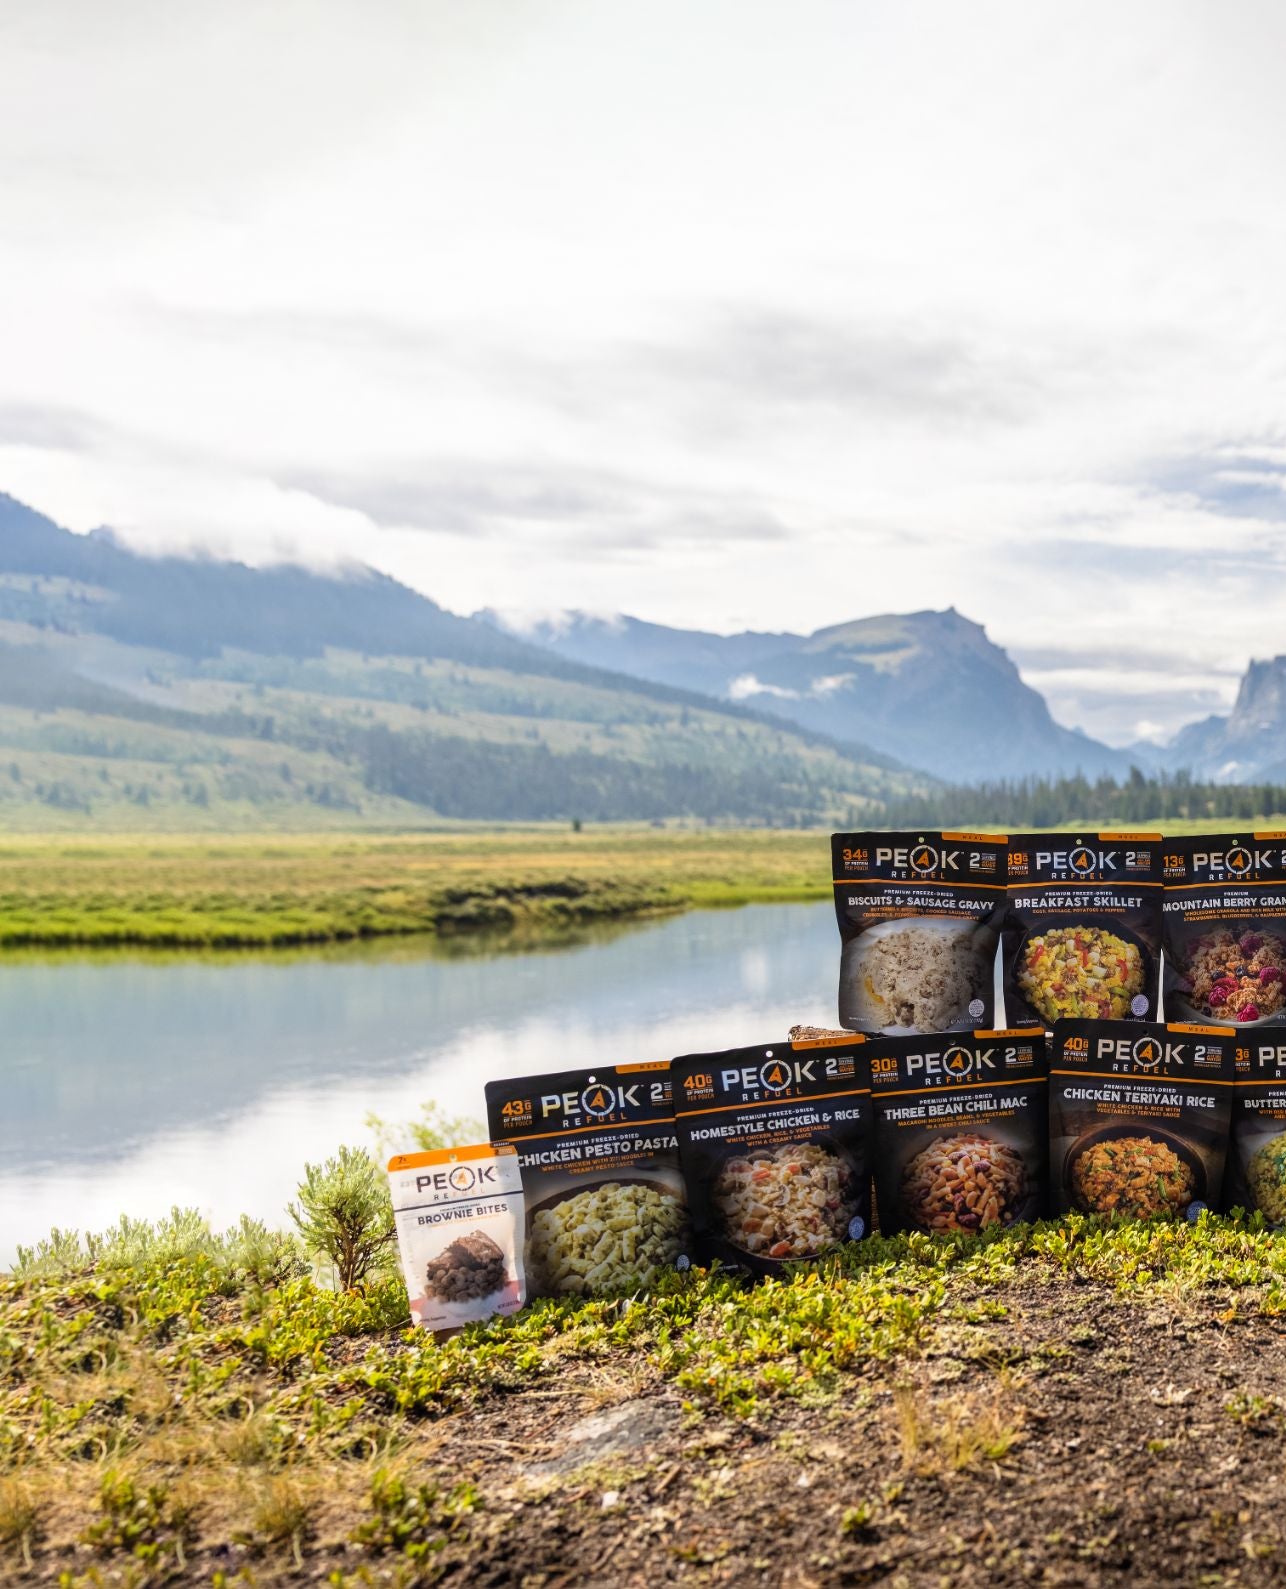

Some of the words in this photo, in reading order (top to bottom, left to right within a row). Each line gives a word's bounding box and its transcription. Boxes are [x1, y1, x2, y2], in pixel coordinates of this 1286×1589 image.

[970, 853, 980, 867] 2
[1126, 852, 1135, 865] 2
[892, 871, 944, 879] REFUEL
[849, 896, 892, 905] BISCUITS
[895, 897, 904, 905] &
[907, 897, 956, 907] SAUSAGE
[959, 901, 995, 910] GRAVY
[1015, 898, 1089, 909] BREAKFAST
[1094, 898, 1142, 907] SKILLET
[1163, 899, 1221, 912] MOUNTAIN
[1224, 898, 1257, 907] BERRY
[1064, 1037, 1088, 1050] 40G
[1005, 1048, 1016, 1062] 2
[1195, 1046, 1205, 1060] 2
[825, 1058, 837, 1074] 2
[1113, 1064, 1168, 1074] REFUEL
[684, 1074, 712, 1089] 40G
[925, 1075, 983, 1085] REFUEL
[651, 1083, 663, 1099] 2
[742, 1088, 802, 1101] REFUEL
[950, 1094, 992, 1102] FREEZE-DRIED
[1063, 1088, 1121, 1101] CHICKEN
[1125, 1093, 1182, 1106] TERIYAKI
[1186, 1095, 1215, 1107] RICE
[502, 1100, 532, 1115] 43G
[737, 1113, 767, 1121] PREMIUM
[768, 1107, 814, 1117] FREEZE-DRIED
[884, 1108, 926, 1120] THREE
[929, 1103, 963, 1116] BEAN
[966, 1099, 997, 1112] CHILI
[1001, 1097, 1028, 1108] MAC
[563, 1112, 627, 1127] REFUEL
[690, 1120, 765, 1141] HOMESTYLE
[767, 1113, 819, 1130] CHICKEN
[823, 1113, 832, 1122] &
[835, 1109, 860, 1120] RICE
[557, 1139, 588, 1148] PREMIUM
[591, 1133, 639, 1144] FREEZE-DRIED
[726, 1136, 745, 1144] WHITE
[796, 1124, 830, 1133] VEGETABLES
[769, 1136, 792, 1144] CREAMY
[517, 1148, 581, 1167] CHICKEN
[585, 1141, 631, 1158] PESTO
[635, 1136, 679, 1150] PASTA
[434, 1188, 485, 1200] REFUEL
[418, 1206, 473, 1225] BROWNIE
[477, 1204, 508, 1216] BITES
